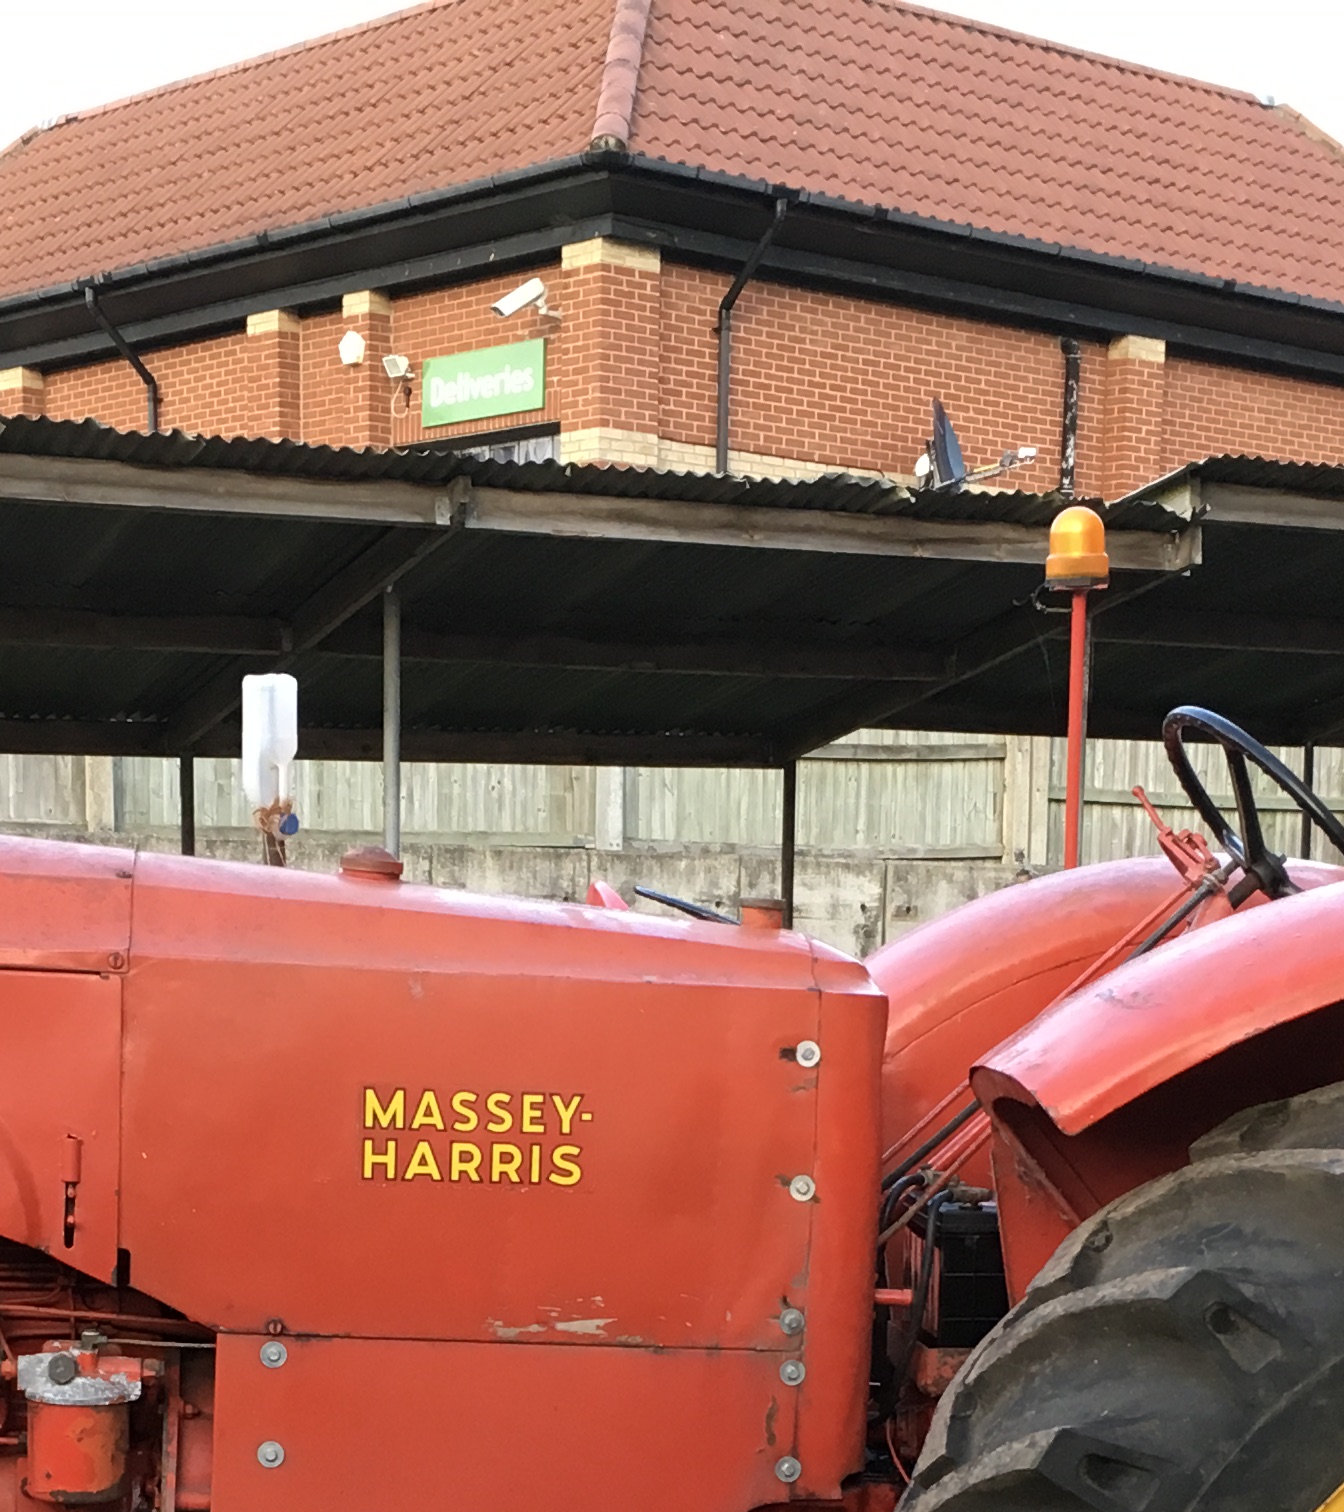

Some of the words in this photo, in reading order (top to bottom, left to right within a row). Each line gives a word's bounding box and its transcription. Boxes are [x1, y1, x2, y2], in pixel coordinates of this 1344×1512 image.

[430, 364, 534, 408] Deliveries
[363, 1087, 594, 1135] MASSEY-
[361, 1138, 583, 1186] HARRIS
